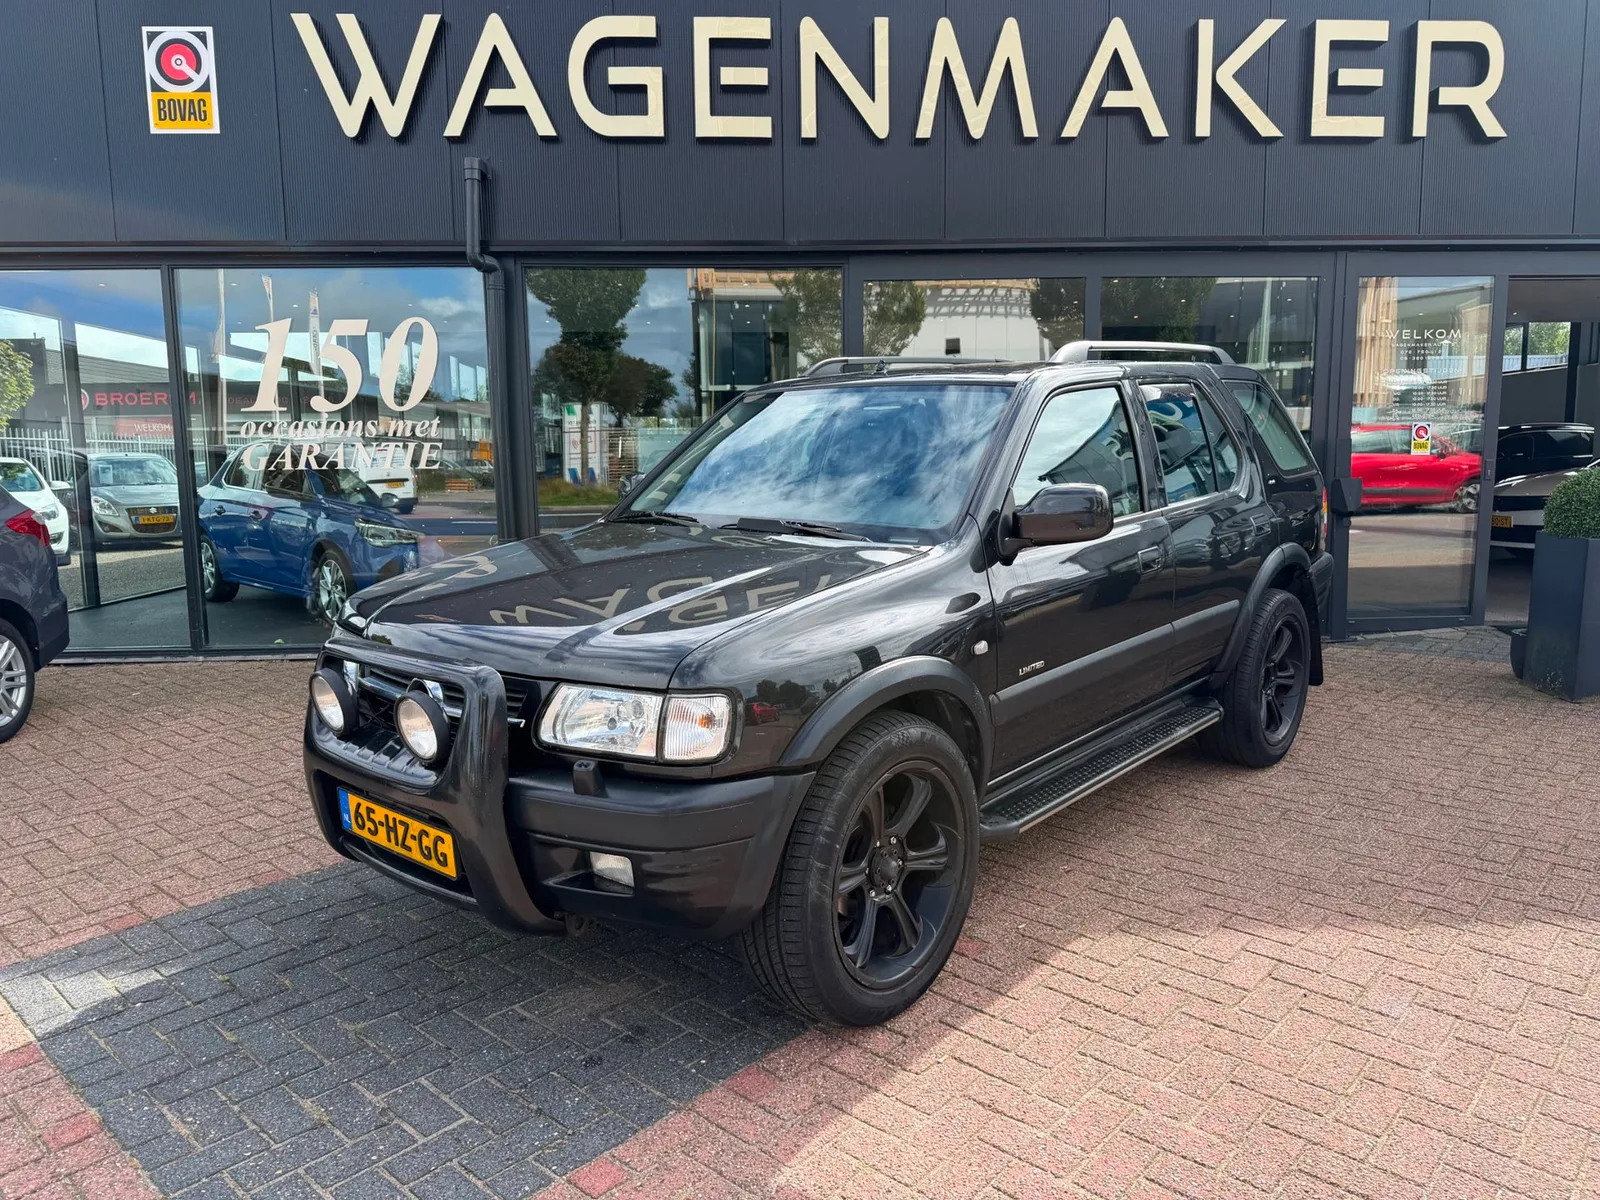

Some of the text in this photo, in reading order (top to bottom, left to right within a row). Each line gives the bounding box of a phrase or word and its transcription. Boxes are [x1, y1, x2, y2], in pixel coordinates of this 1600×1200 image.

[290, 13, 1507, 139] WAGENMAKER
[157, 98, 207, 122] BOVAG
[1385, 329, 1461, 339] WELKOM
[241, 317, 438, 412] 150
[134, 424, 171, 432] WELKOM
[240, 412, 441, 438] occasions met
[243, 442, 444, 472] GARANTIE
[1413, 442, 1428, 450] BOVAG
[1018, 660, 1045, 676] LIMITED
[354, 802, 448, 868] 65-HZ-GG
